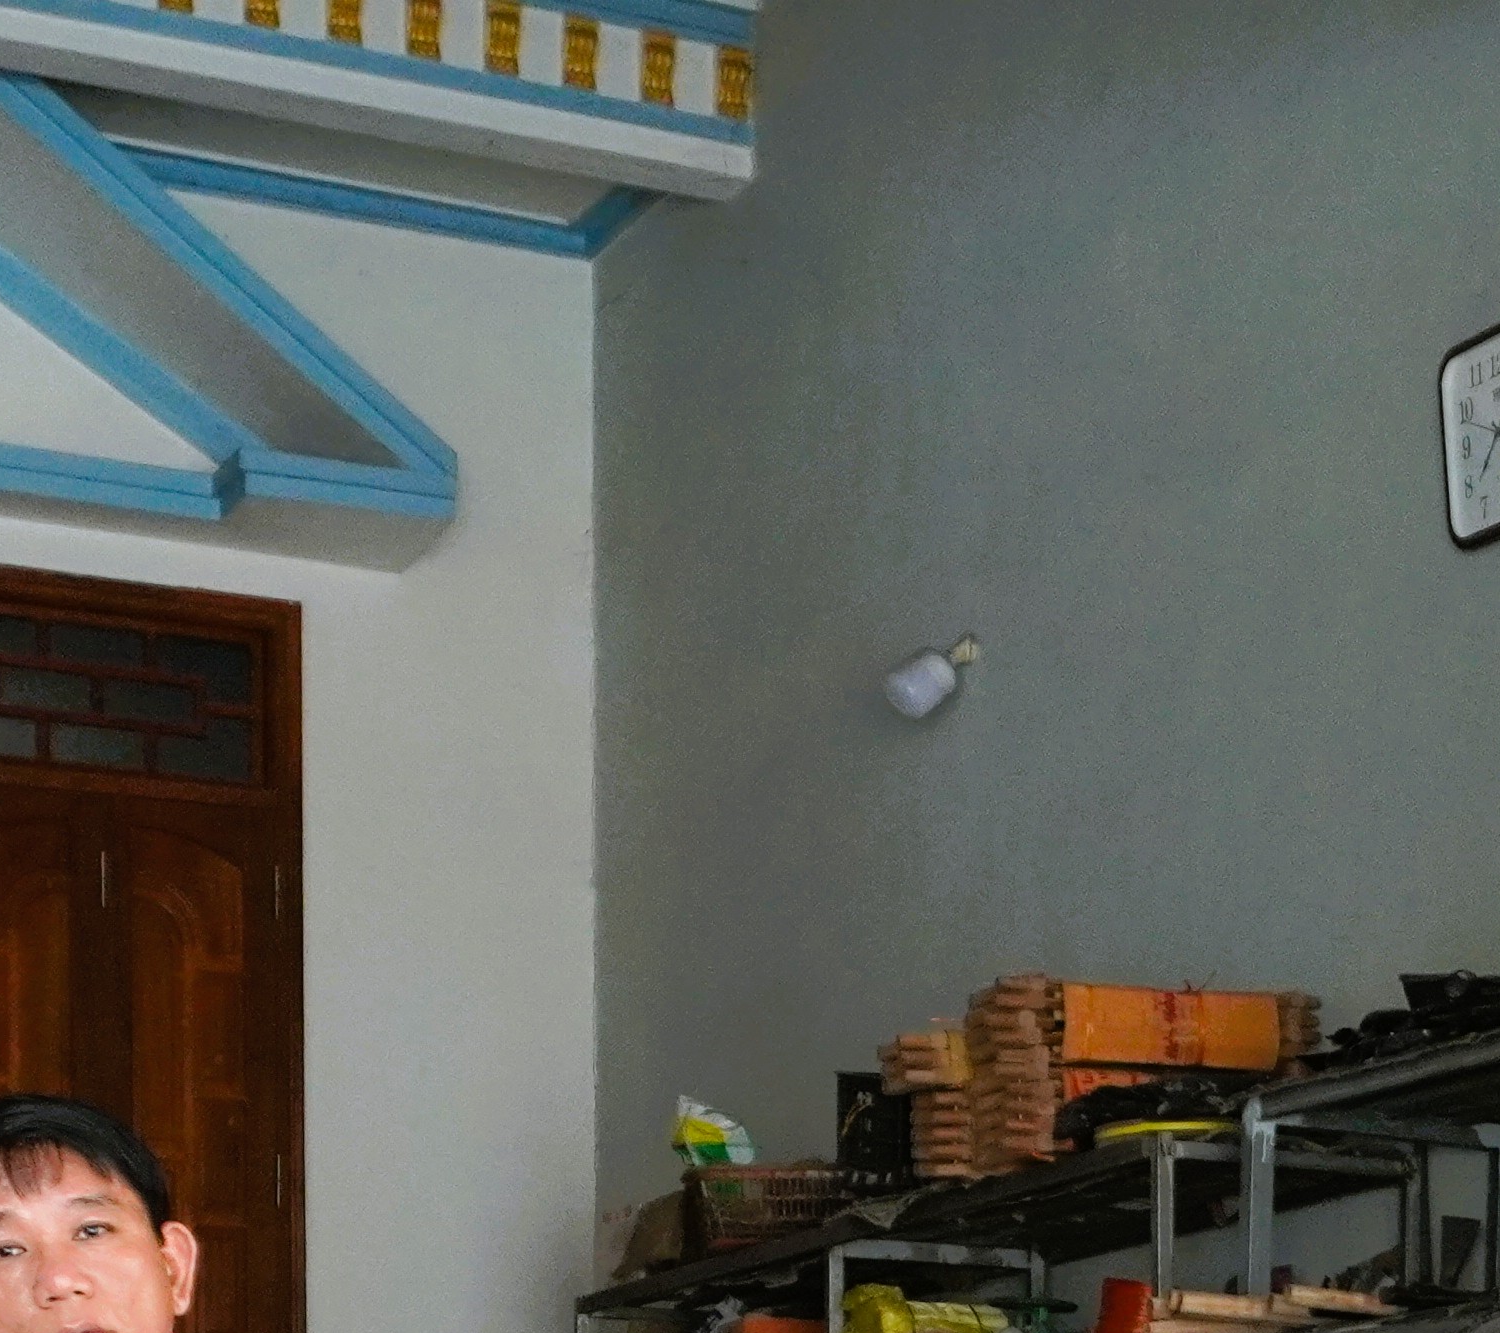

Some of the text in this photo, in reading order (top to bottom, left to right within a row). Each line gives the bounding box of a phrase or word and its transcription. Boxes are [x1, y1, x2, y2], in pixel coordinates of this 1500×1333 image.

[1468, 361, 1483, 389] 11
[1458, 396, 1474, 425] 10
[1462, 435, 1471, 460] 9
[1464, 474, 1473, 499] 8
[1479, 495, 1488, 519] 7
